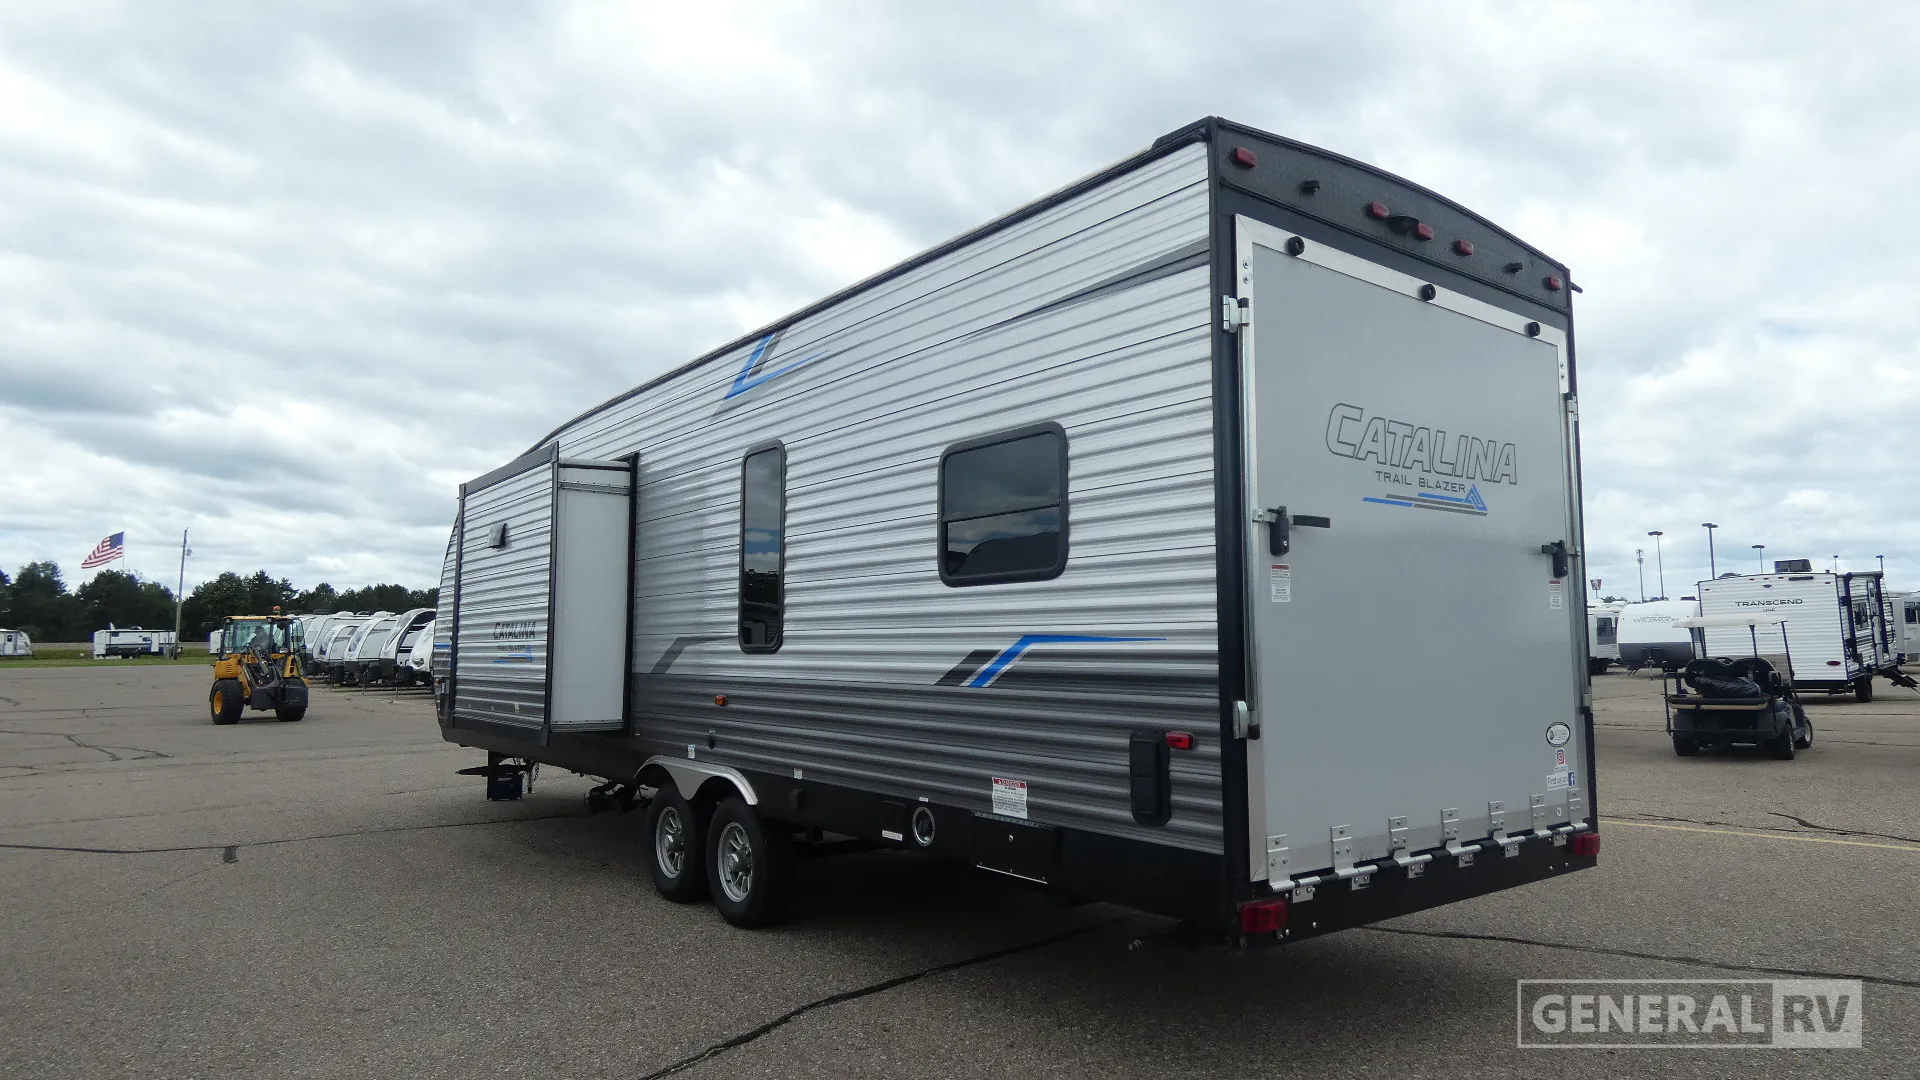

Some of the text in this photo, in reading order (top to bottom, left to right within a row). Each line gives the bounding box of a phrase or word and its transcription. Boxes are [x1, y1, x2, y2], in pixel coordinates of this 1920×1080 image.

[1326, 402, 1518, 486] CATALINA
[1375, 470, 1466, 494] TRAIL BLAZER
[1735, 598, 1803, 607] TRANSCEND
[493, 621, 536, 640] CATALINA
